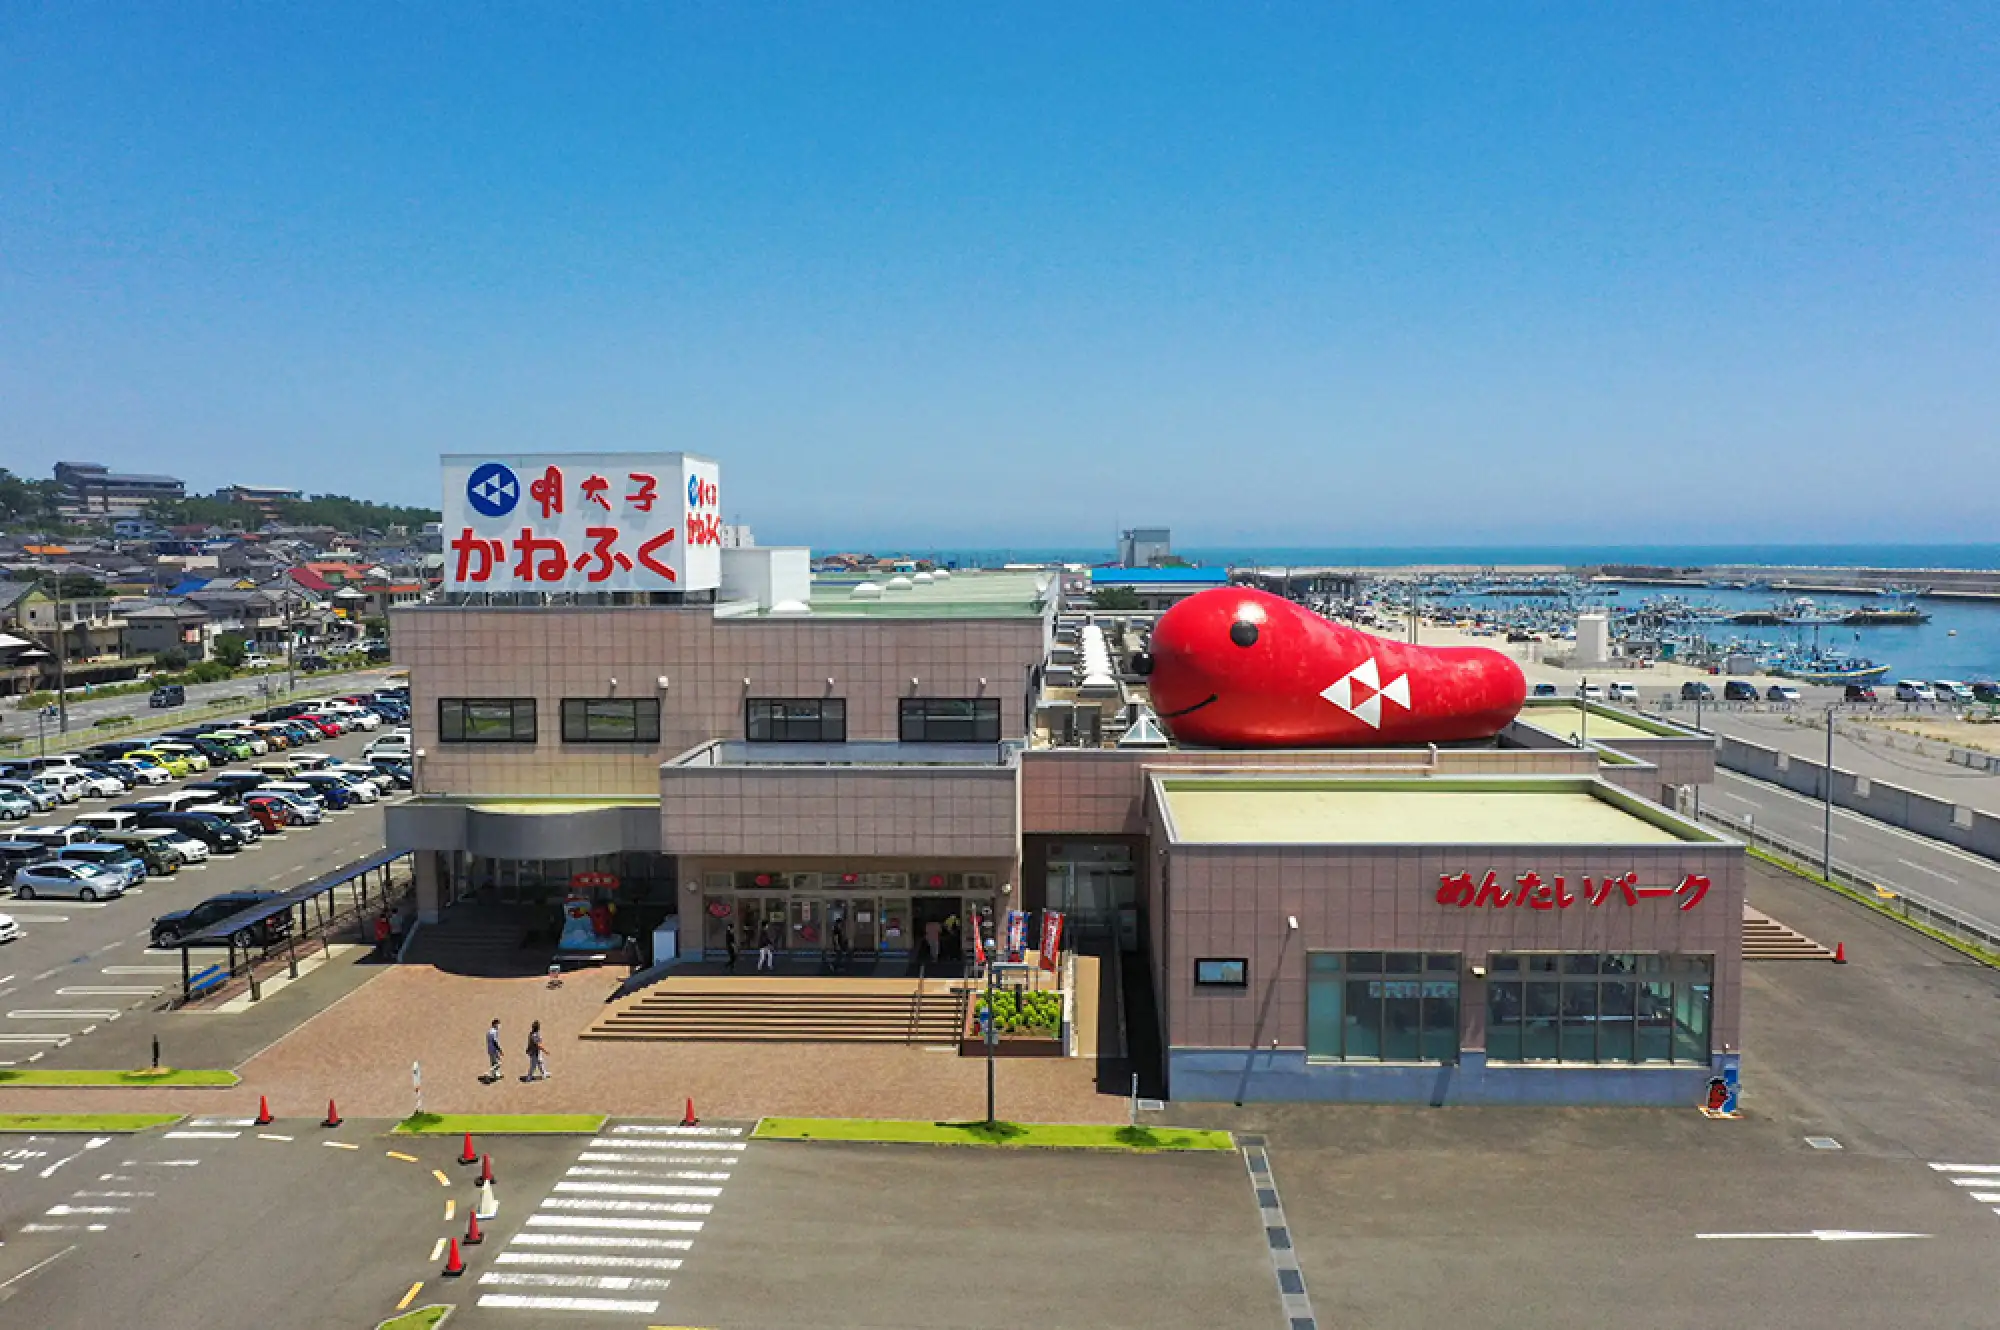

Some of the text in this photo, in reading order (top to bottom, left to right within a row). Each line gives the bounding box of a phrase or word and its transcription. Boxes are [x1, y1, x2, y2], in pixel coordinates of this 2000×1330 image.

[530, 464, 659, 519] 明太子
[451, 527, 677, 583] かねふく
[1436, 869, 1711, 912] めんたいパーク
